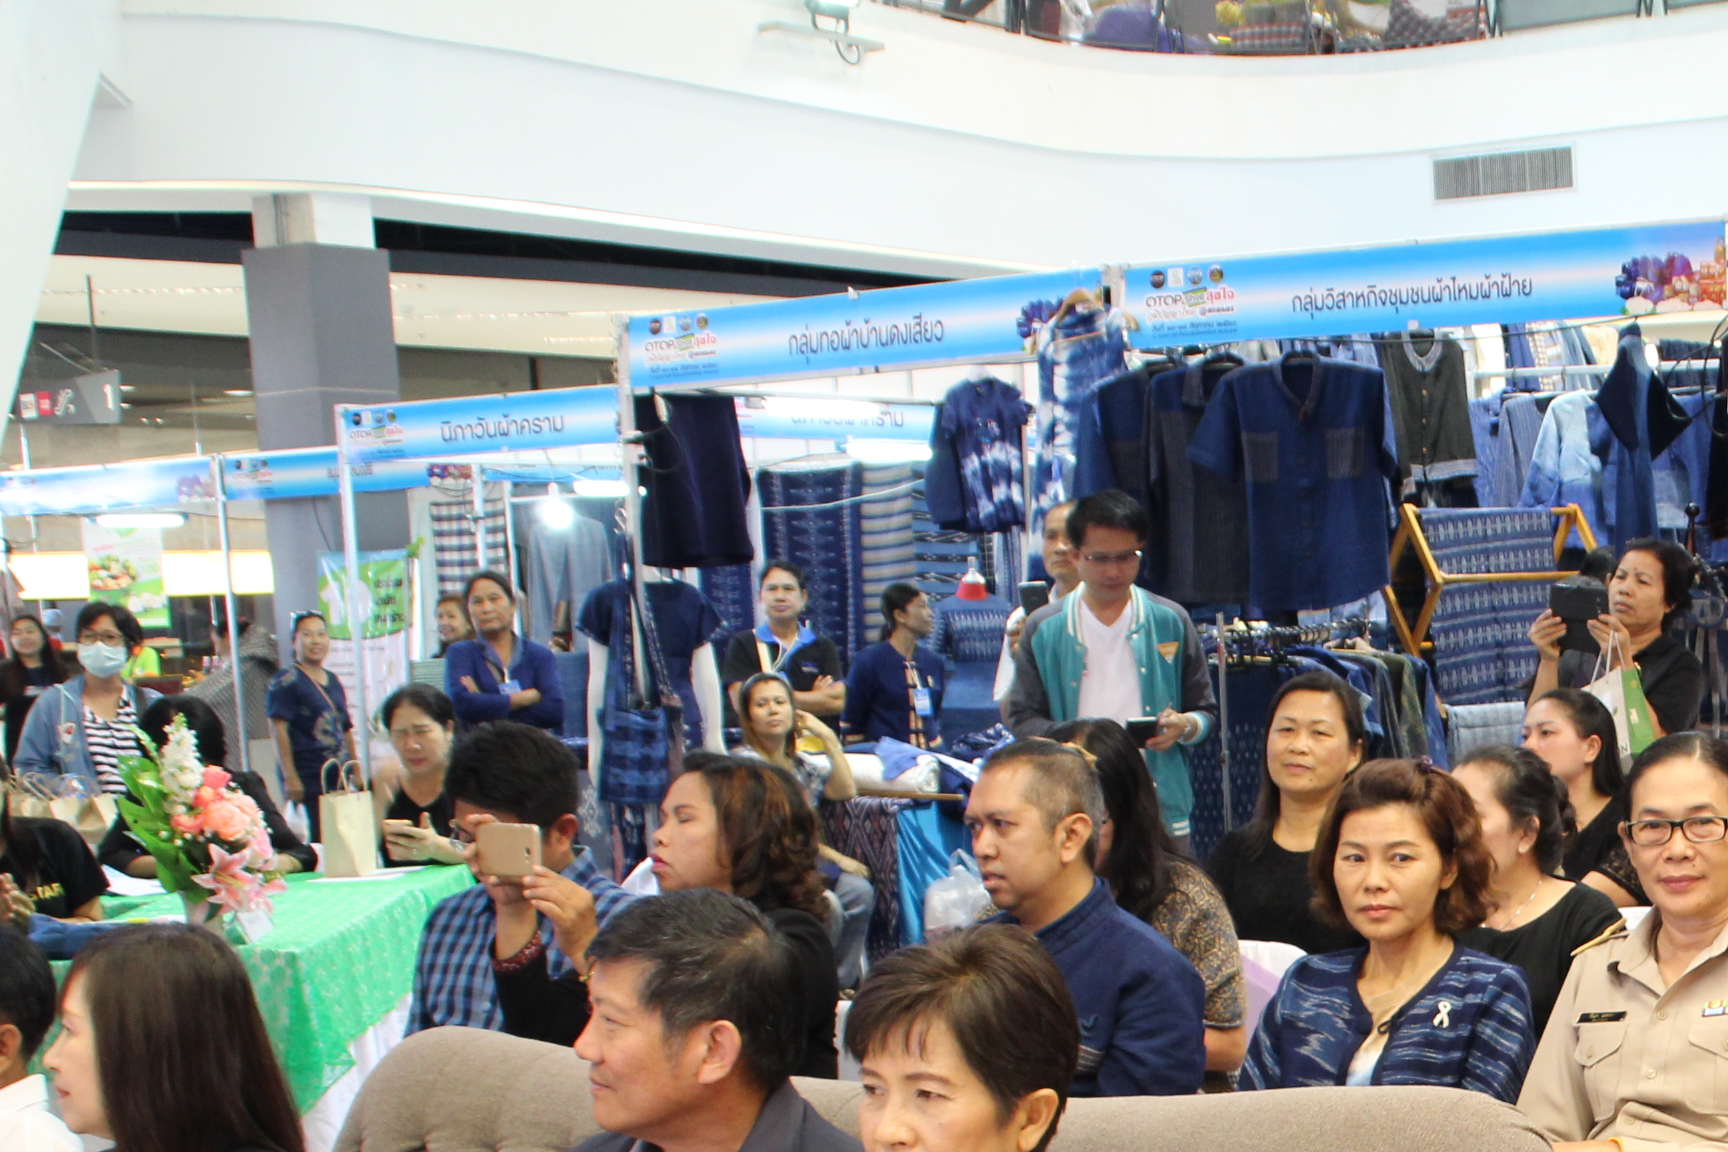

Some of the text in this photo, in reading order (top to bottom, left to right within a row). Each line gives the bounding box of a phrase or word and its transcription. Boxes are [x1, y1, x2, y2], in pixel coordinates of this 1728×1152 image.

[1146, 294, 1182, 307] OTOP
[1206, 286, 1235, 304] สุขใจ
[1292, 273, 1533, 319] กลุ่มวิสาหกิจชุมชนผ้าไหมผ้าฝ้าย
[644, 339, 674, 352] OTOP
[788, 312, 945, 365] กลุ่มทอผ้าบ้านดงเสียว
[102, 383, 114, 411] 1
[441, 413, 564, 442] นิภาวันผ้าคราม
